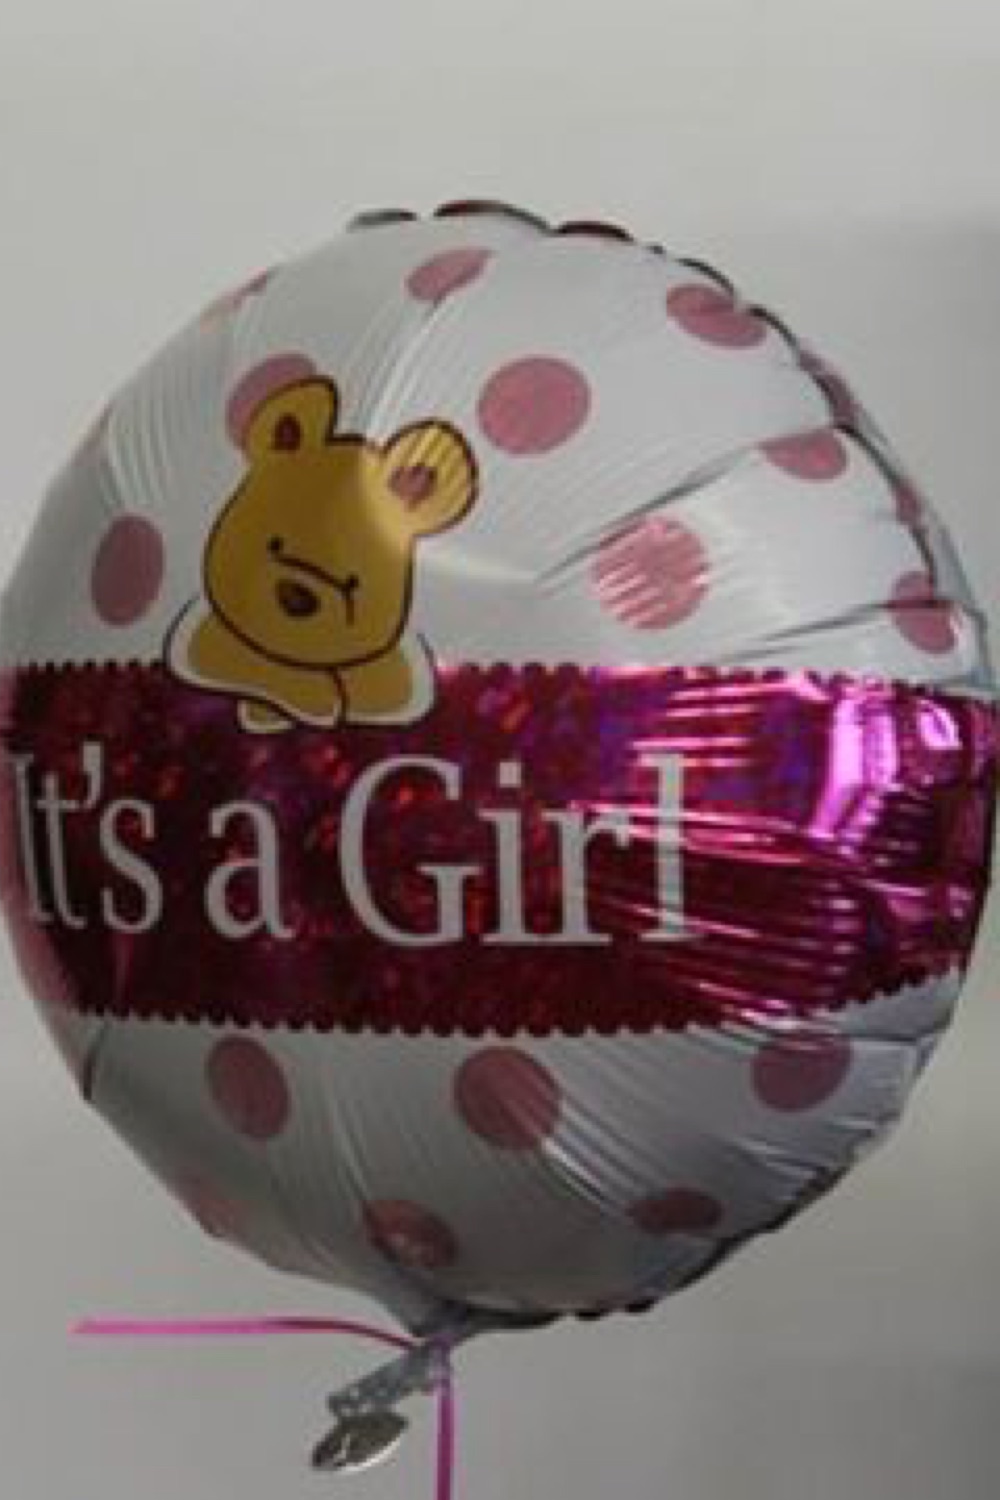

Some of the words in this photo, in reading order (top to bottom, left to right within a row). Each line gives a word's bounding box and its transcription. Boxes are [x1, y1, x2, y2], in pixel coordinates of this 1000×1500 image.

[8, 742, 163, 935] It's
[203, 800, 293, 940] a
[338, 753, 706, 946] Girl
